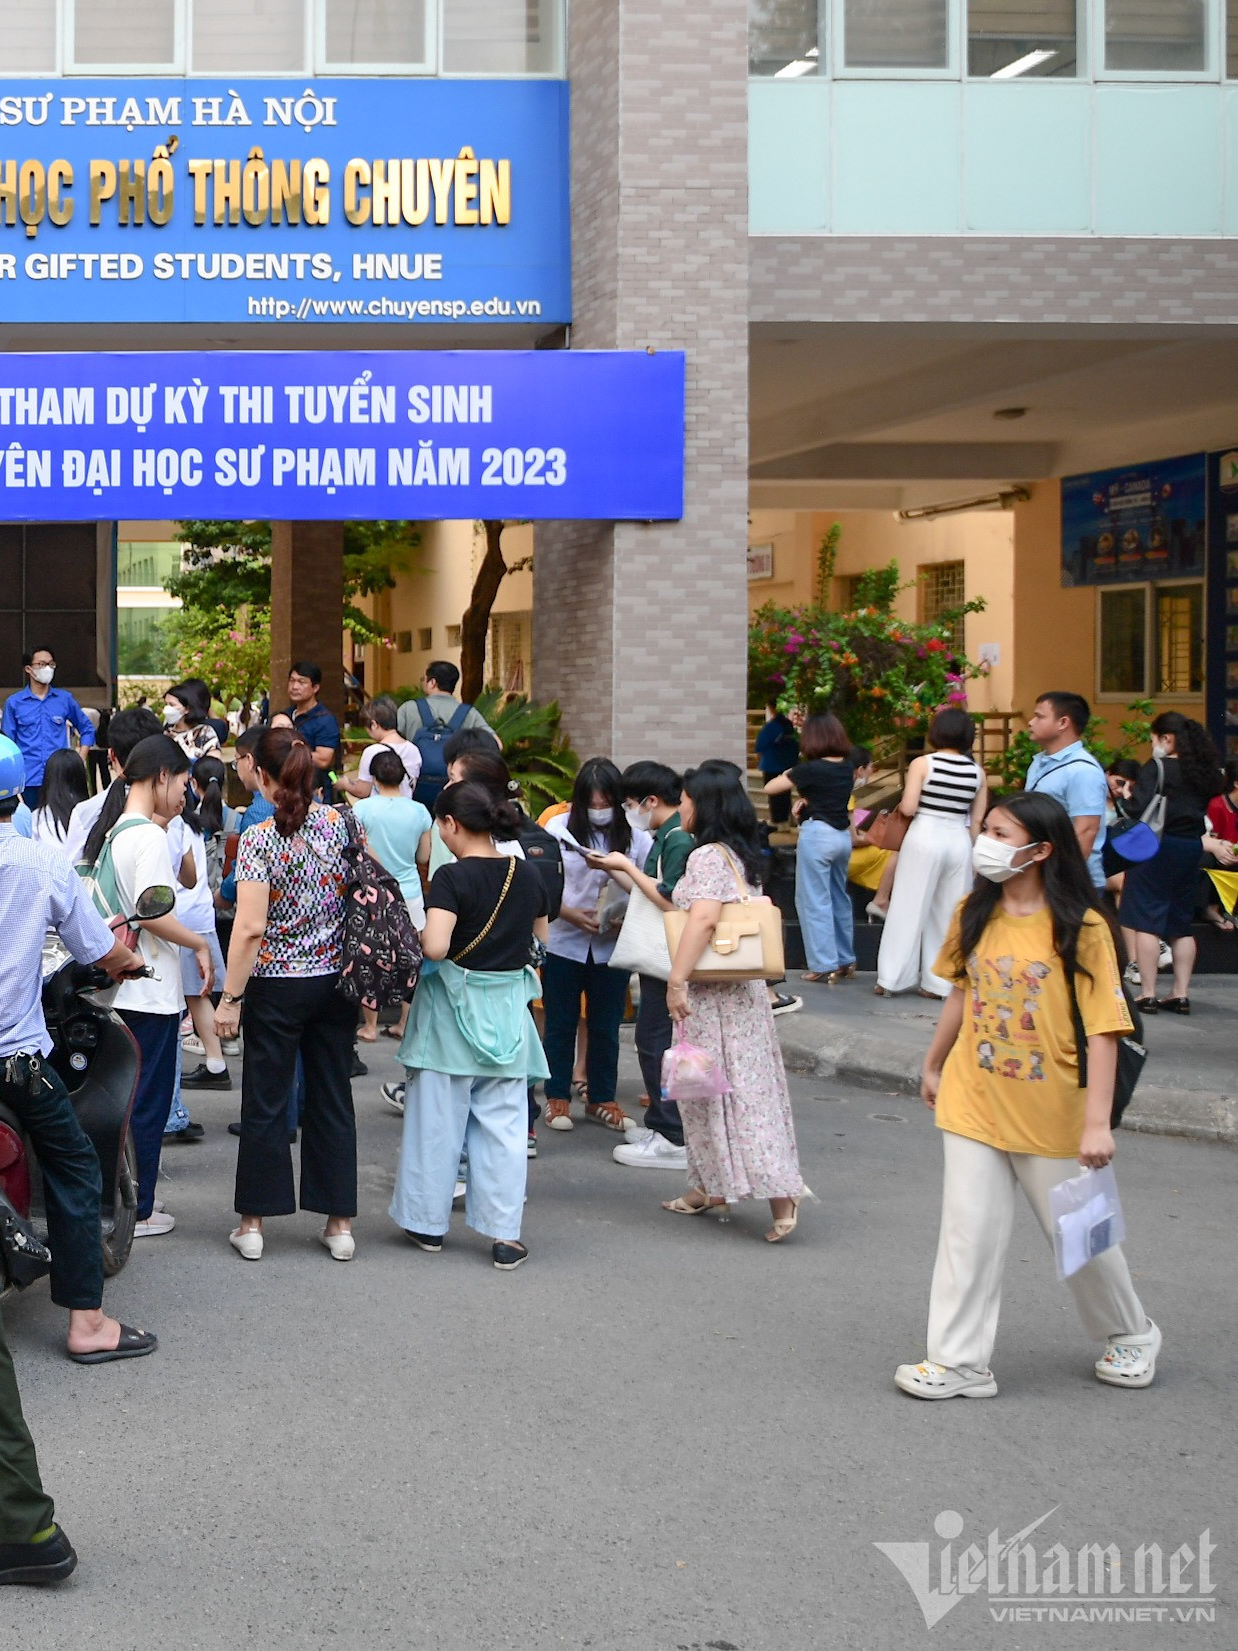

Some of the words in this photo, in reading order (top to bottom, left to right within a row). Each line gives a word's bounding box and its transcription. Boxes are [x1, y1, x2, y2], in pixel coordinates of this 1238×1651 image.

[0, 92, 54, 125] SƯ
[60, 96, 183, 132] PHẠM
[191, 89, 253, 126] HÀ
[263, 88, 338, 133] NỘI
[89, 134, 180, 226] PHỔ
[188, 146, 331, 226] THÔNG
[343, 145, 512, 226] CHUYÊN
[24, 253, 144, 280] GIFTED
[153, 252, 342, 283] STUDENTS,
[352, 253, 443, 280] HNUE
[248, 296, 541, 320] http://www.chuyensp.edu.vn
[106, 382, 157, 433] DỰ
[164, 377, 209, 424] KỲ
[219, 386, 273, 424] THI
[284, 369, 396, 424] TUYỂN
[407, 384, 493, 424] SINH
[61, 449, 121, 496] ĐẠI
[133, 448, 203, 495] HỌC
[214, 444, 266, 486] SƯ
[273, 448, 376, 494] PHẠM
[388, 439, 470, 486] NĂM
[481, 447, 567, 486] 2023
